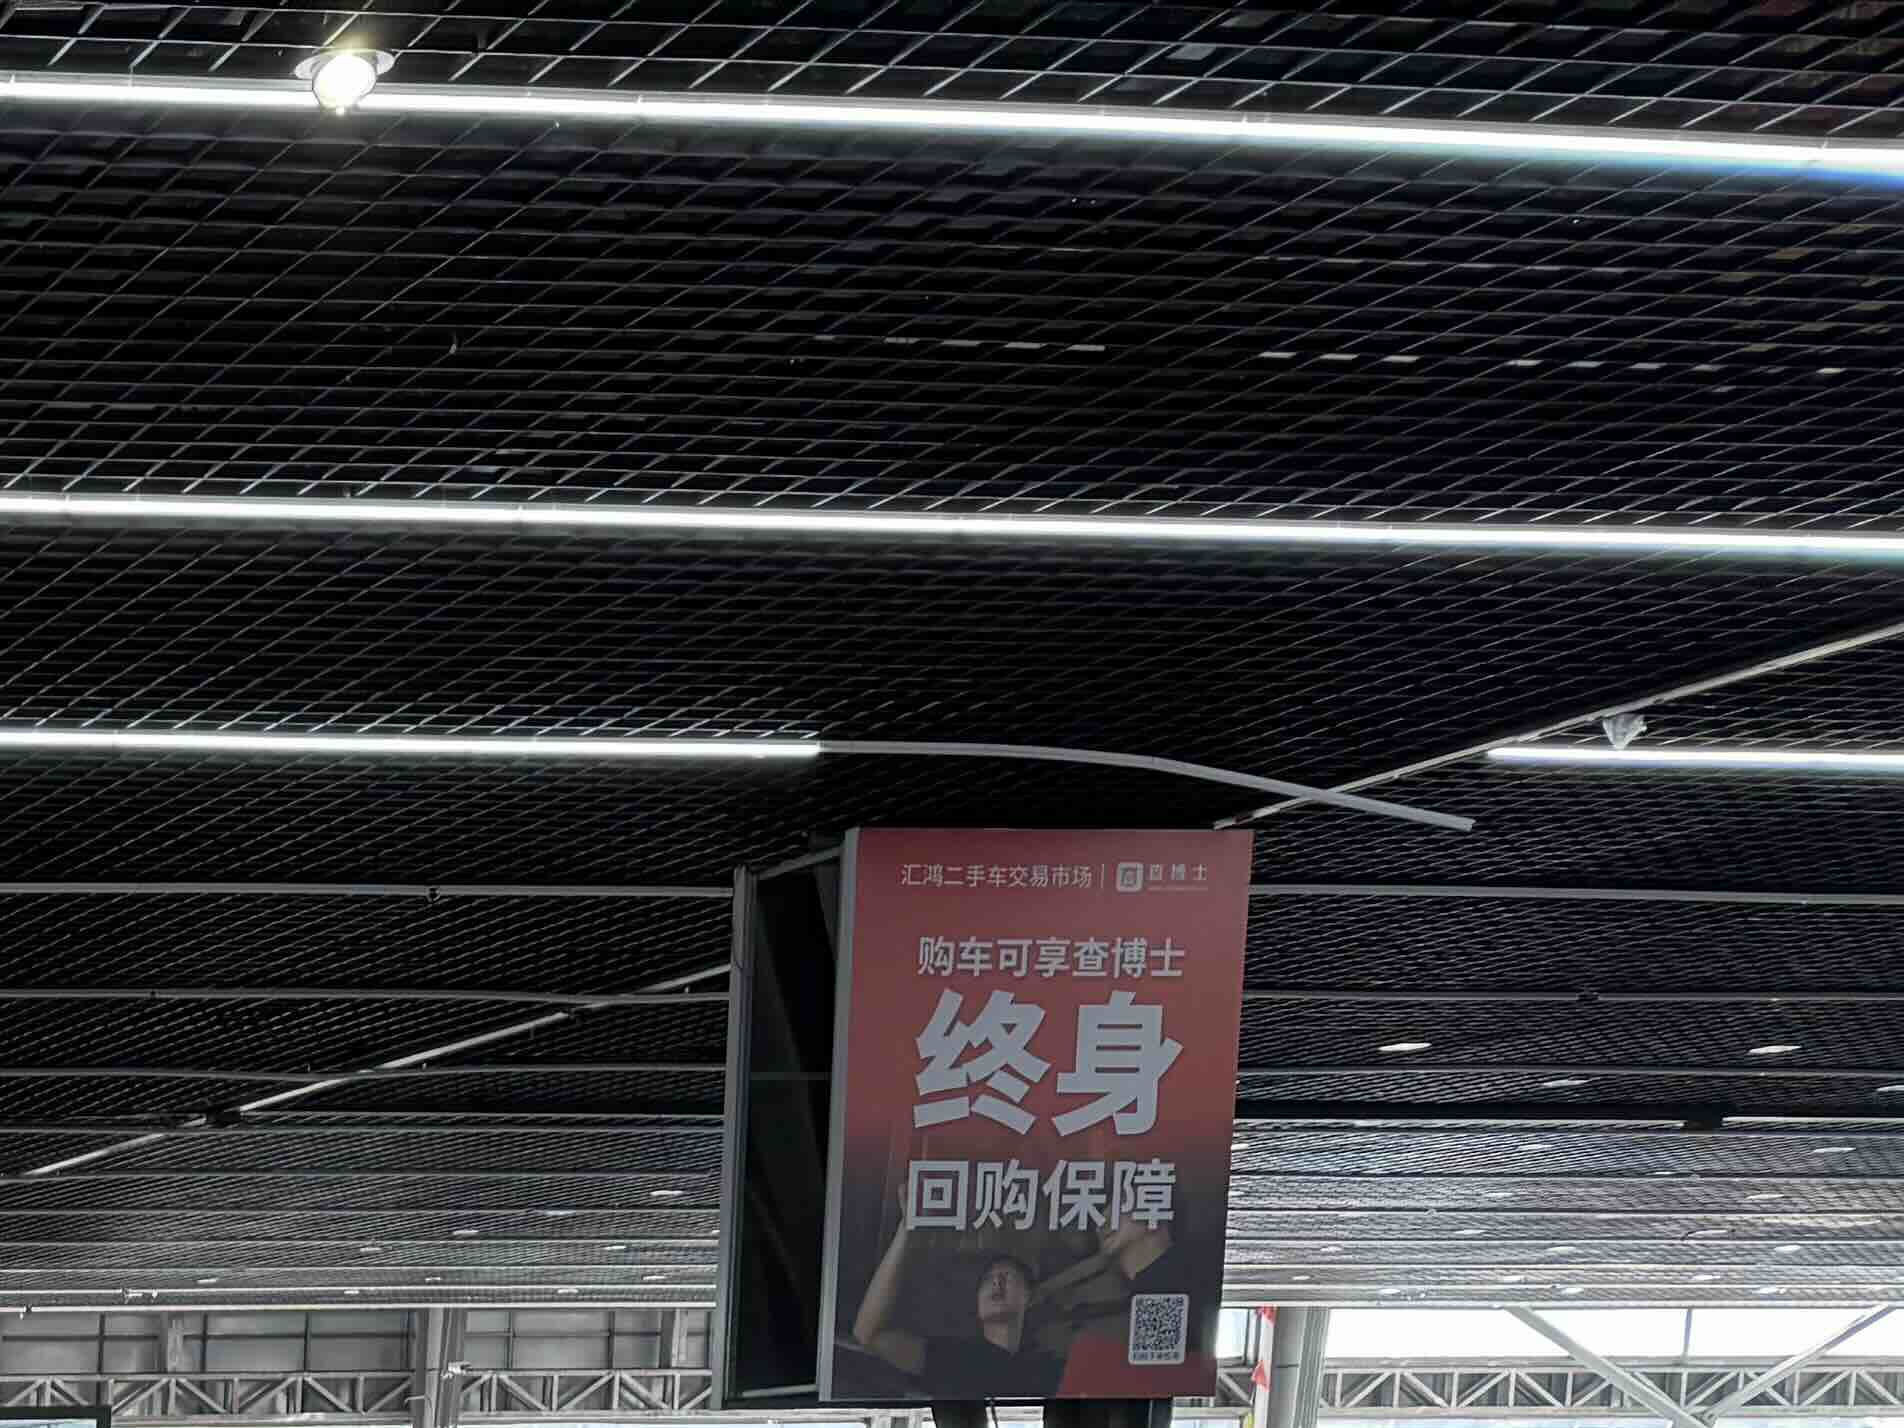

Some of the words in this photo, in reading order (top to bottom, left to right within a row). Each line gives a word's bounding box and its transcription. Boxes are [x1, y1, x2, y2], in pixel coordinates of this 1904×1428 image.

[900, 863, 1093, 890] 汇鸿二手车交易市场
[918, 935, 1186, 979] 购车可享查博士
[912, 987, 1185, 1138] 终身
[904, 1157, 1177, 1232] 回购保障
